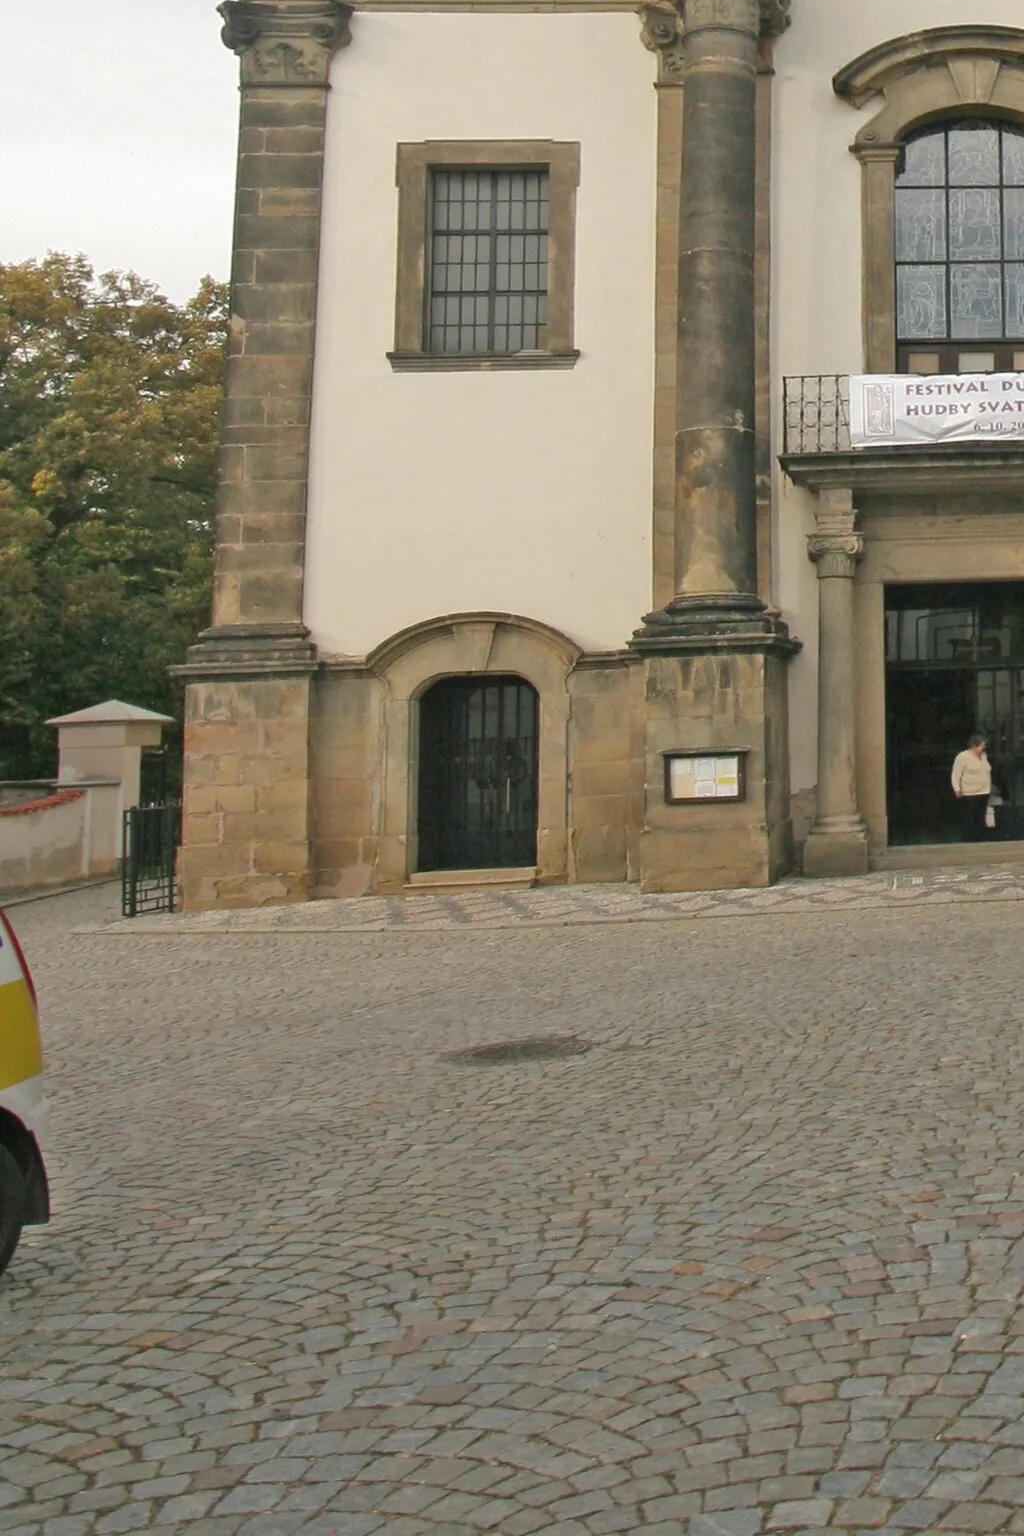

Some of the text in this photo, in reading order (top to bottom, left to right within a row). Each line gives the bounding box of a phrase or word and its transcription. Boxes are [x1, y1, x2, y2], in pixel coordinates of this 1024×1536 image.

[905, 381, 988, 395] FESTIVAL
[906, 403, 971, 416] HUDBY
[989, 422, 1006, 432] 10.
